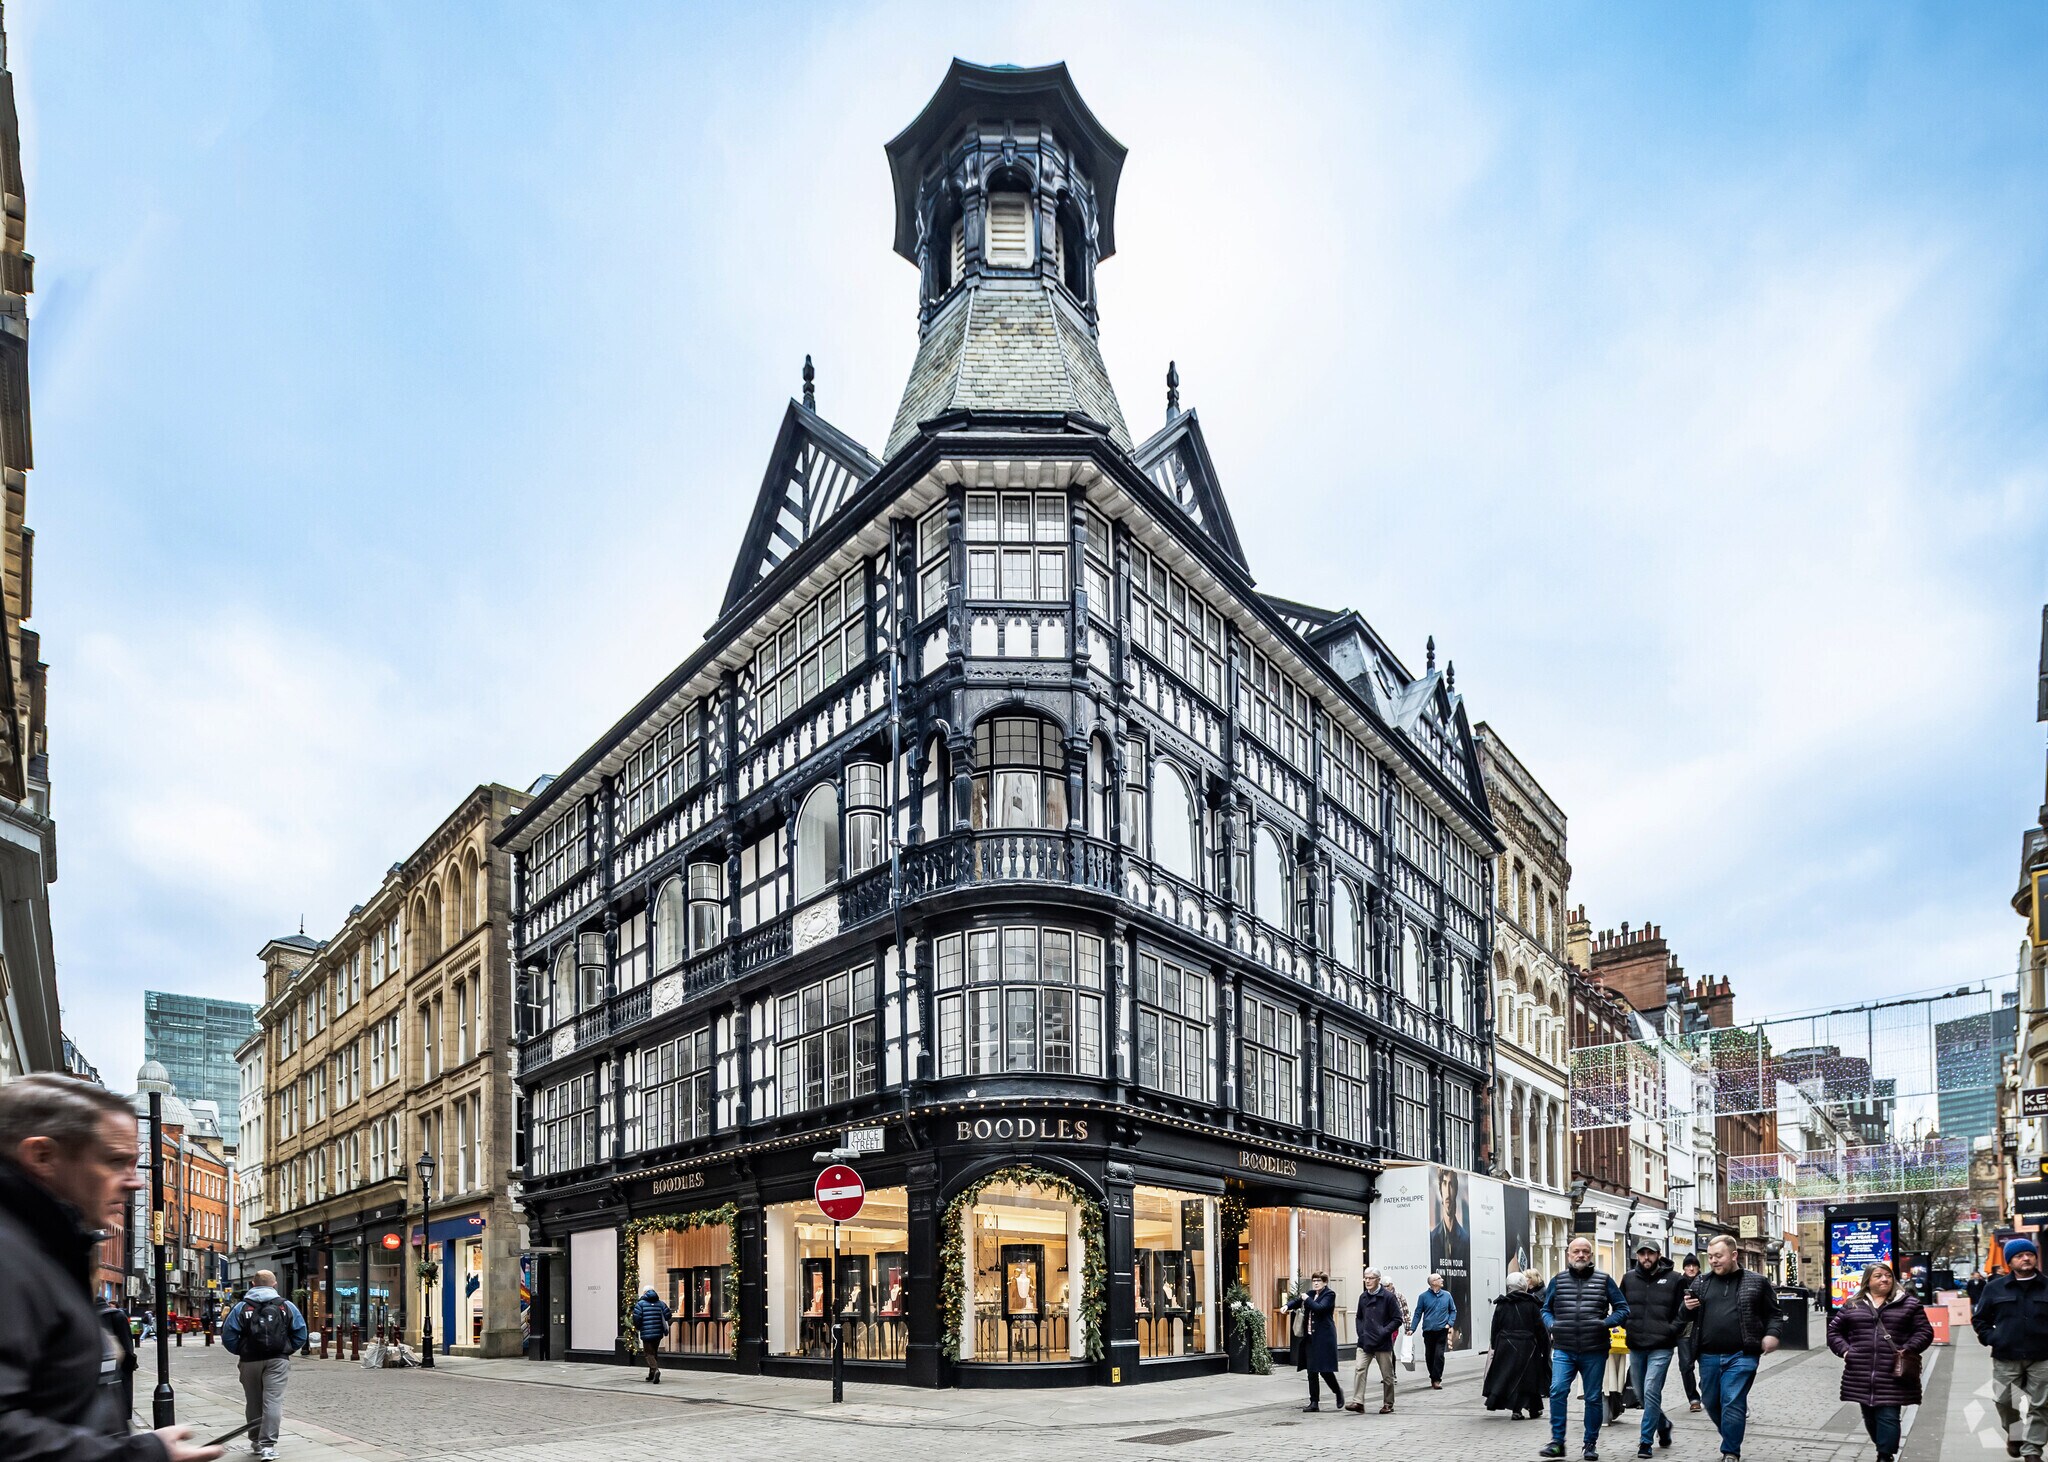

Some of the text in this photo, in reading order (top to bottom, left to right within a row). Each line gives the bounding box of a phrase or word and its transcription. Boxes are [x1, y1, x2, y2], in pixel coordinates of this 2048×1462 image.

[2024, 1093, 2048, 1105] KE
[853, 1129, 880, 1141] POLICE
[957, 1119, 1088, 1141] BOODLES
[851, 1140, 879, 1150] STREET
[1240, 1151, 1297, 1177] BOODLES
[653, 1172, 705, 1195] BOODLES
[1440, 1258, 1463, 1267] BEGIN YOUR
[1446, 1269, 1467, 1277] TRADITION
